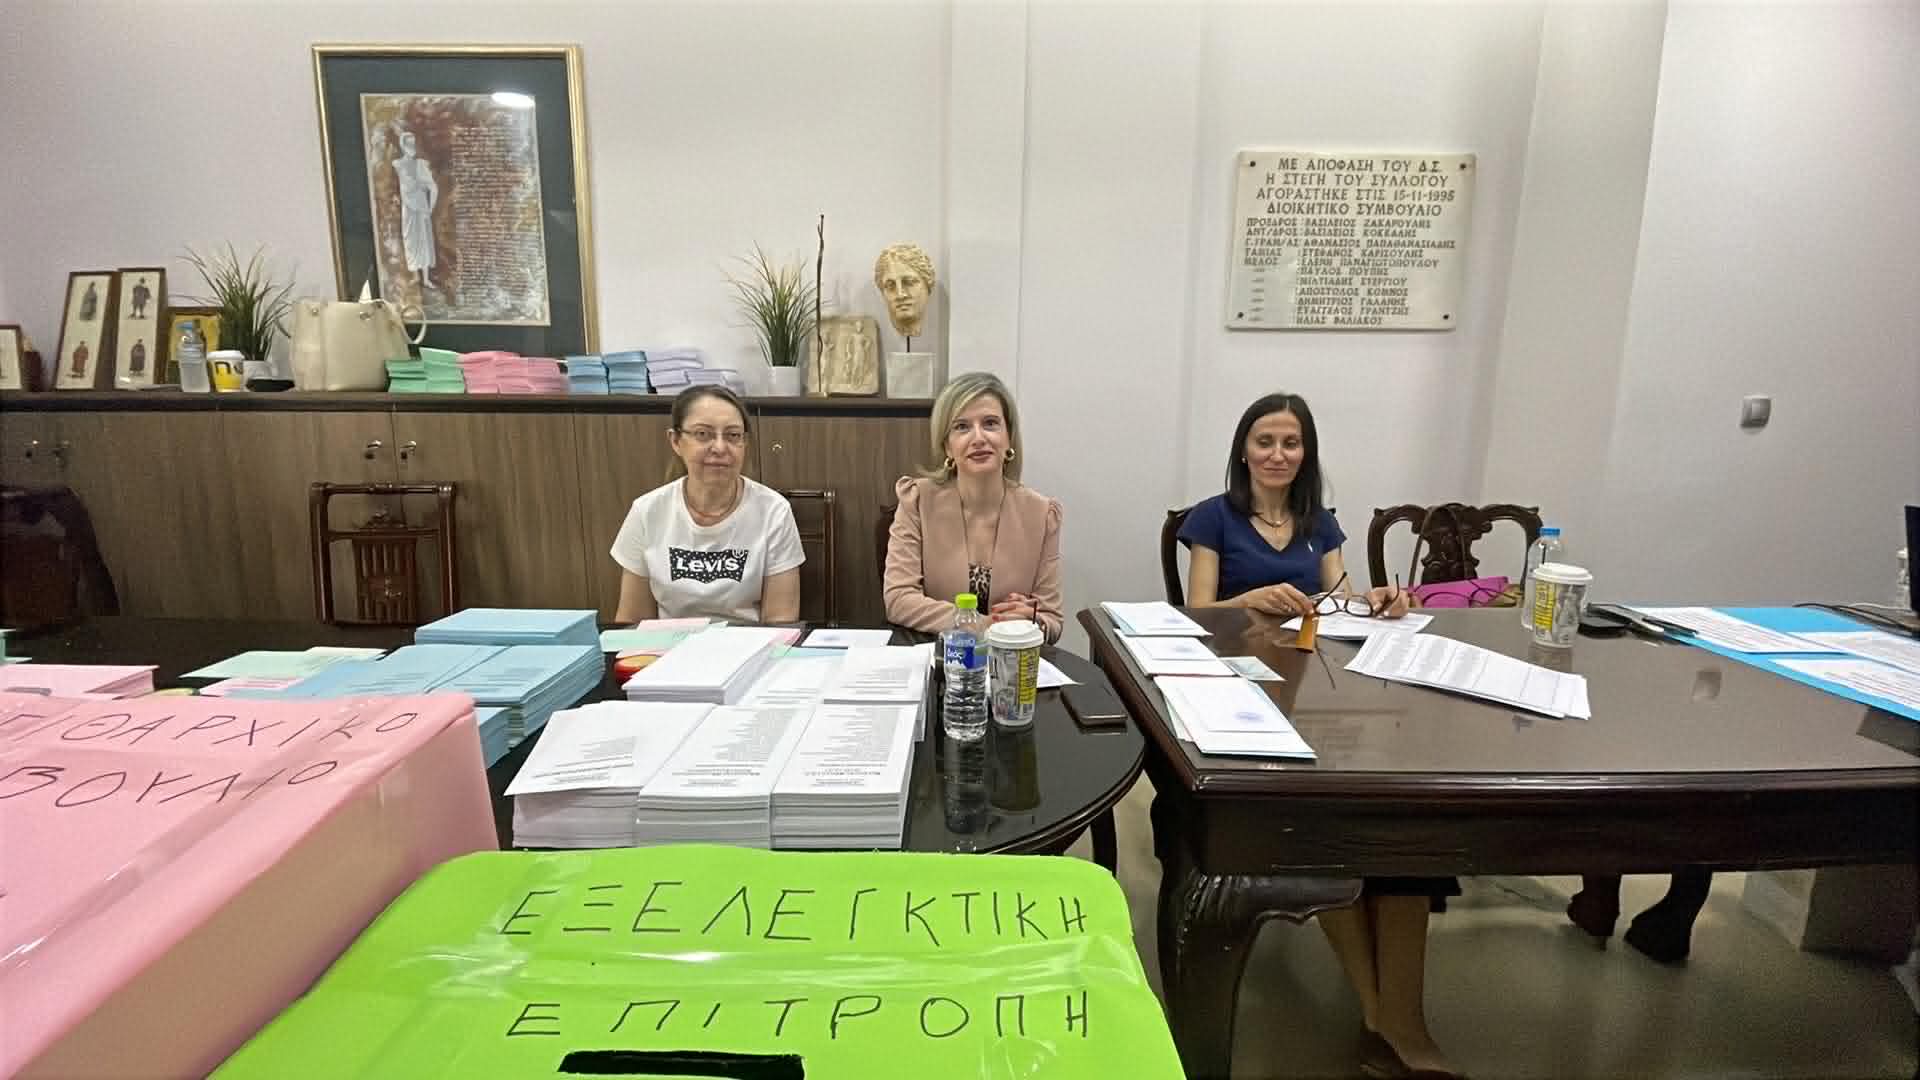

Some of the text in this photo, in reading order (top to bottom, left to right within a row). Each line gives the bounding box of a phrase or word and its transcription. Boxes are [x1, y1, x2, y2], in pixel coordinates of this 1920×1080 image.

[1278, 158, 1298, 171] ΜΕ
[1306, 159, 1374, 172] ΑΠΟΦΑΣΗ
[1383, 160, 1411, 172] ΤΟΥ
[1266, 172, 1449, 188] Η ΣΤΕΓΗ ΤΟΥ ΣΥΛΛΟΓΟΥ
[1256, 187, 1349, 201] ΑΓΟΡΑΣΤΗΚΕ
[1356, 188, 1386, 201] ΣΤΙΣ
[1267, 201, 1442, 217] ΔΙΟΙΚΗΤΙΚΟ ΣΥΜΒΟΥΛΙΟ
[500, 881, 1088, 947] ΕΞΕΛΕΓΚΤΙΚΗ
[505, 990, 1088, 1040] ΕΠΙΤΡΟΠΗ
